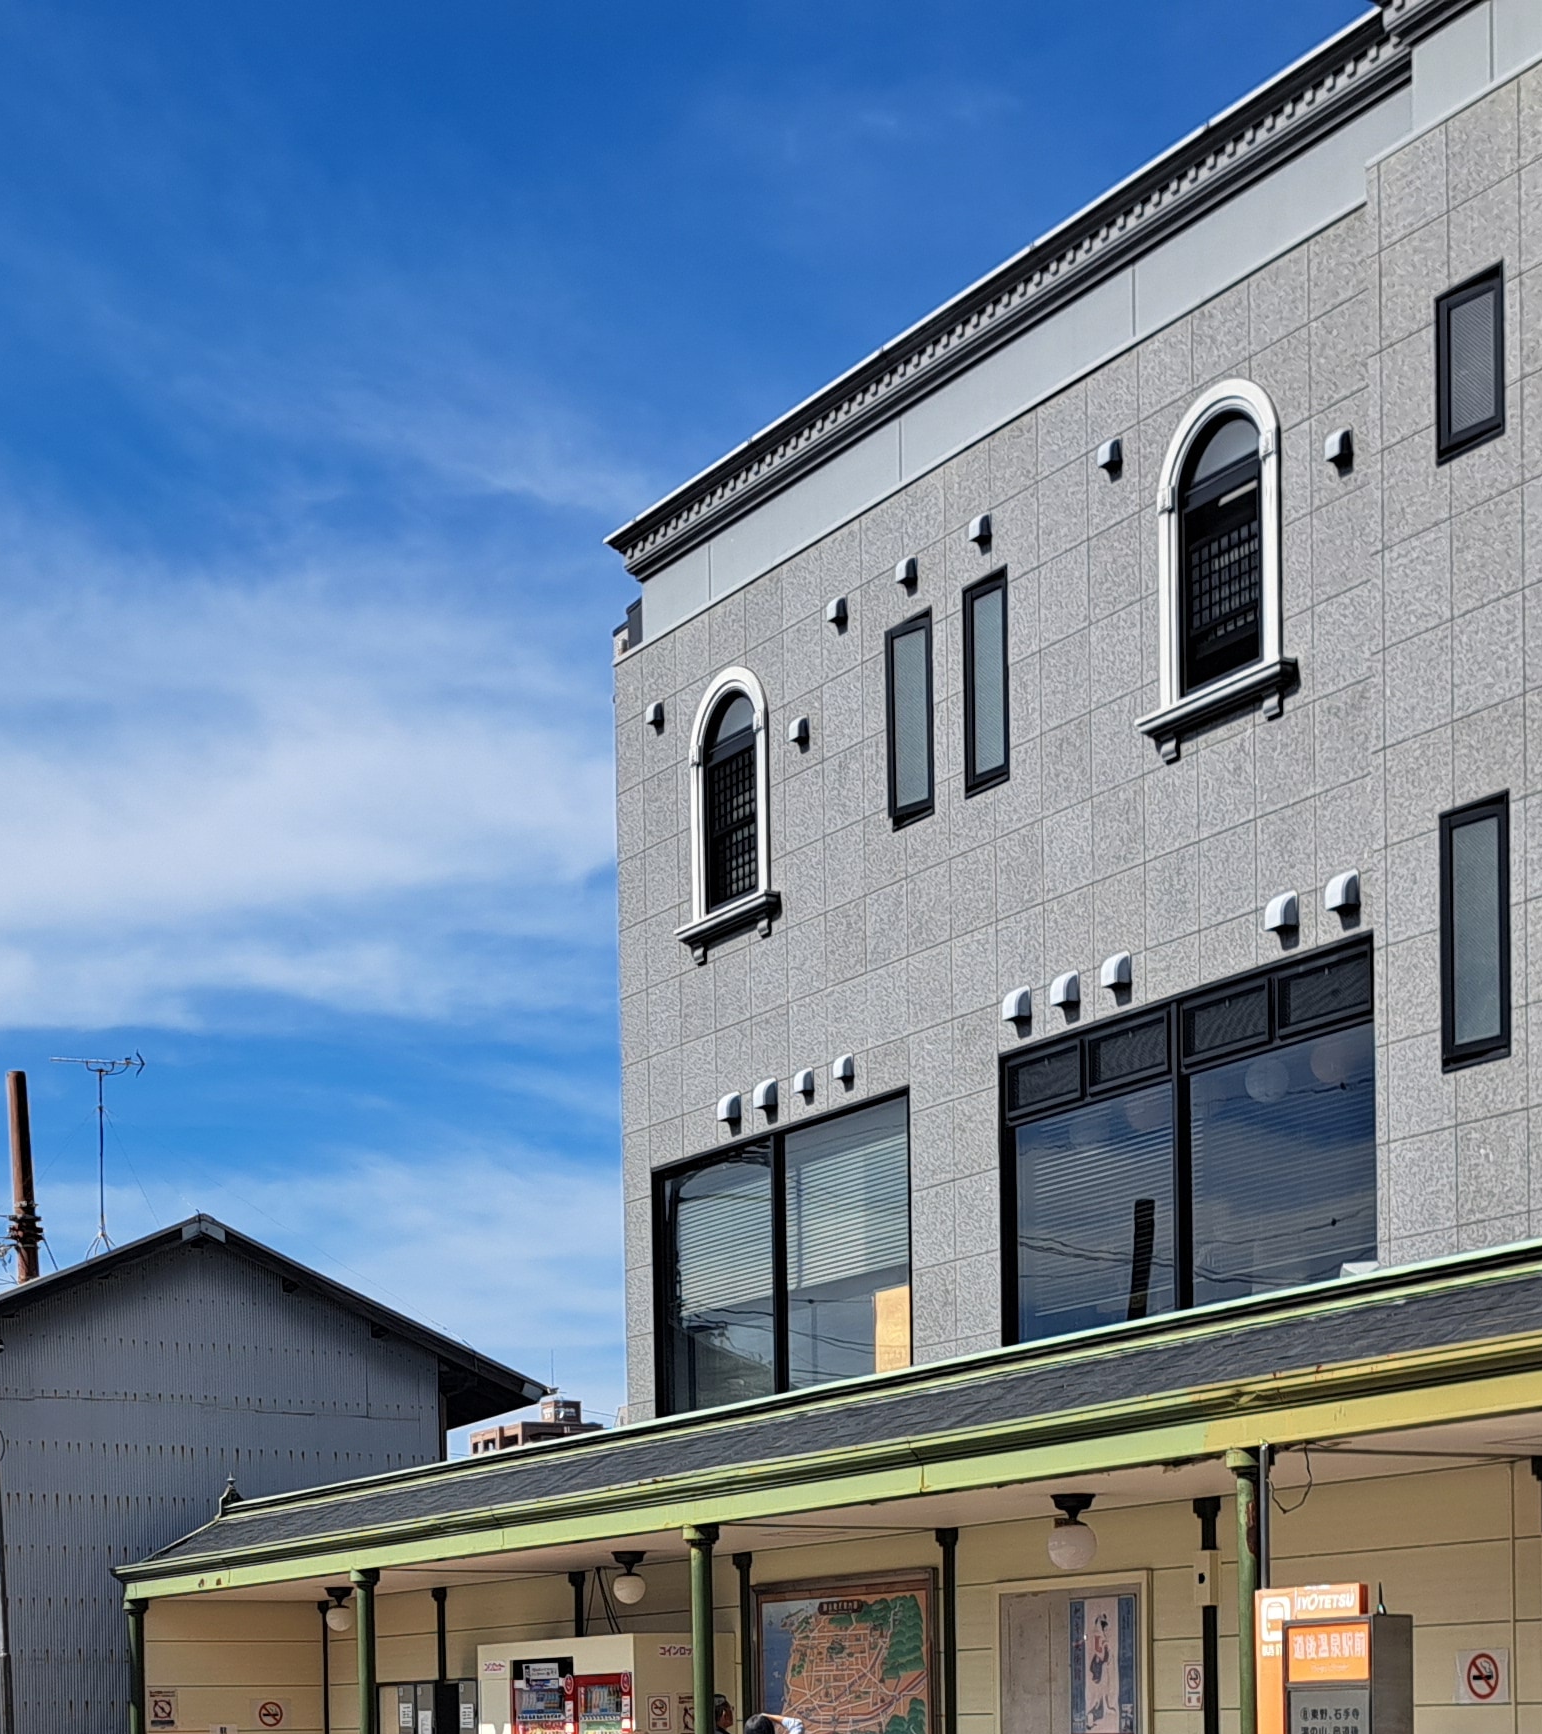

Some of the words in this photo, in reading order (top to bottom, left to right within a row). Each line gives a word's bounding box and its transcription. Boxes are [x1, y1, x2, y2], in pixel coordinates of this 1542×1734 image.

[1296, 1592, 1355, 1611] IYOTETSU
[659, 1645, 694, 1656] コインロッ
[1293, 1631, 1366, 1660] 道後温泉駅前
